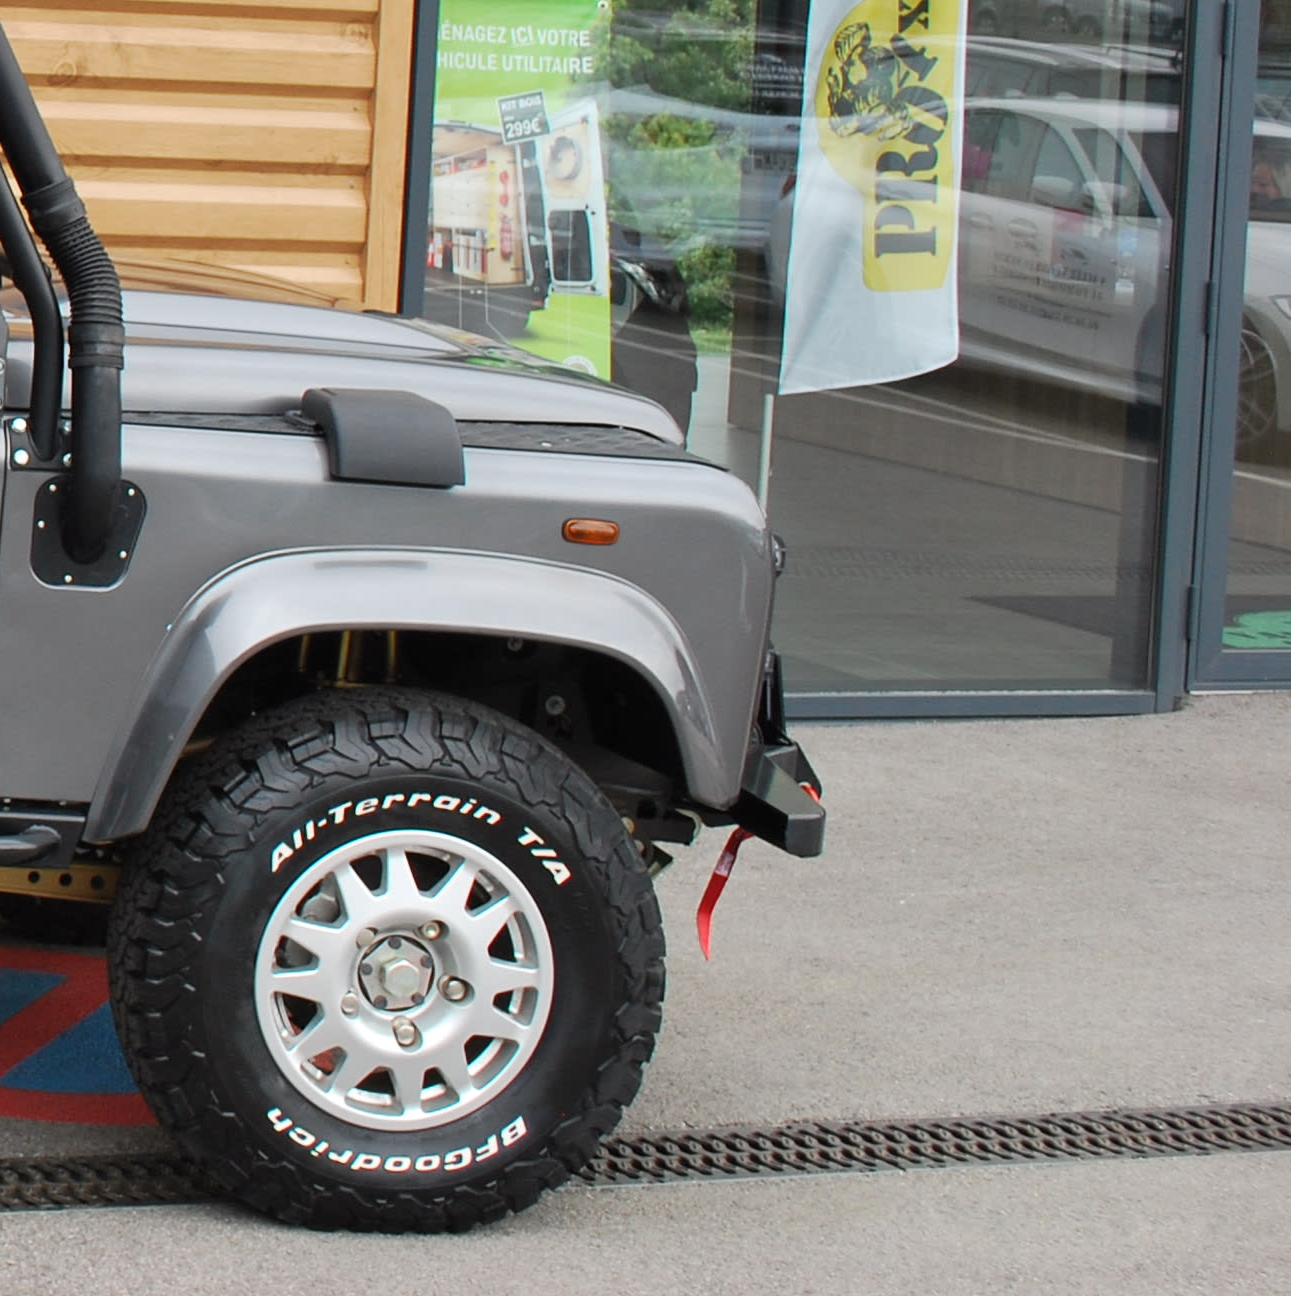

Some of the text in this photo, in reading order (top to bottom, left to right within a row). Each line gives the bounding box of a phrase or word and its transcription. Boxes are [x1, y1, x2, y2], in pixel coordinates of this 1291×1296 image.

[437, 20, 591, 47] ÉNAGEZ ICI VOTRE
[502, 55, 595, 74] UTILITAIRE
[505, 118, 542, 139] 299€
[518, 827, 571, 885] T/A
